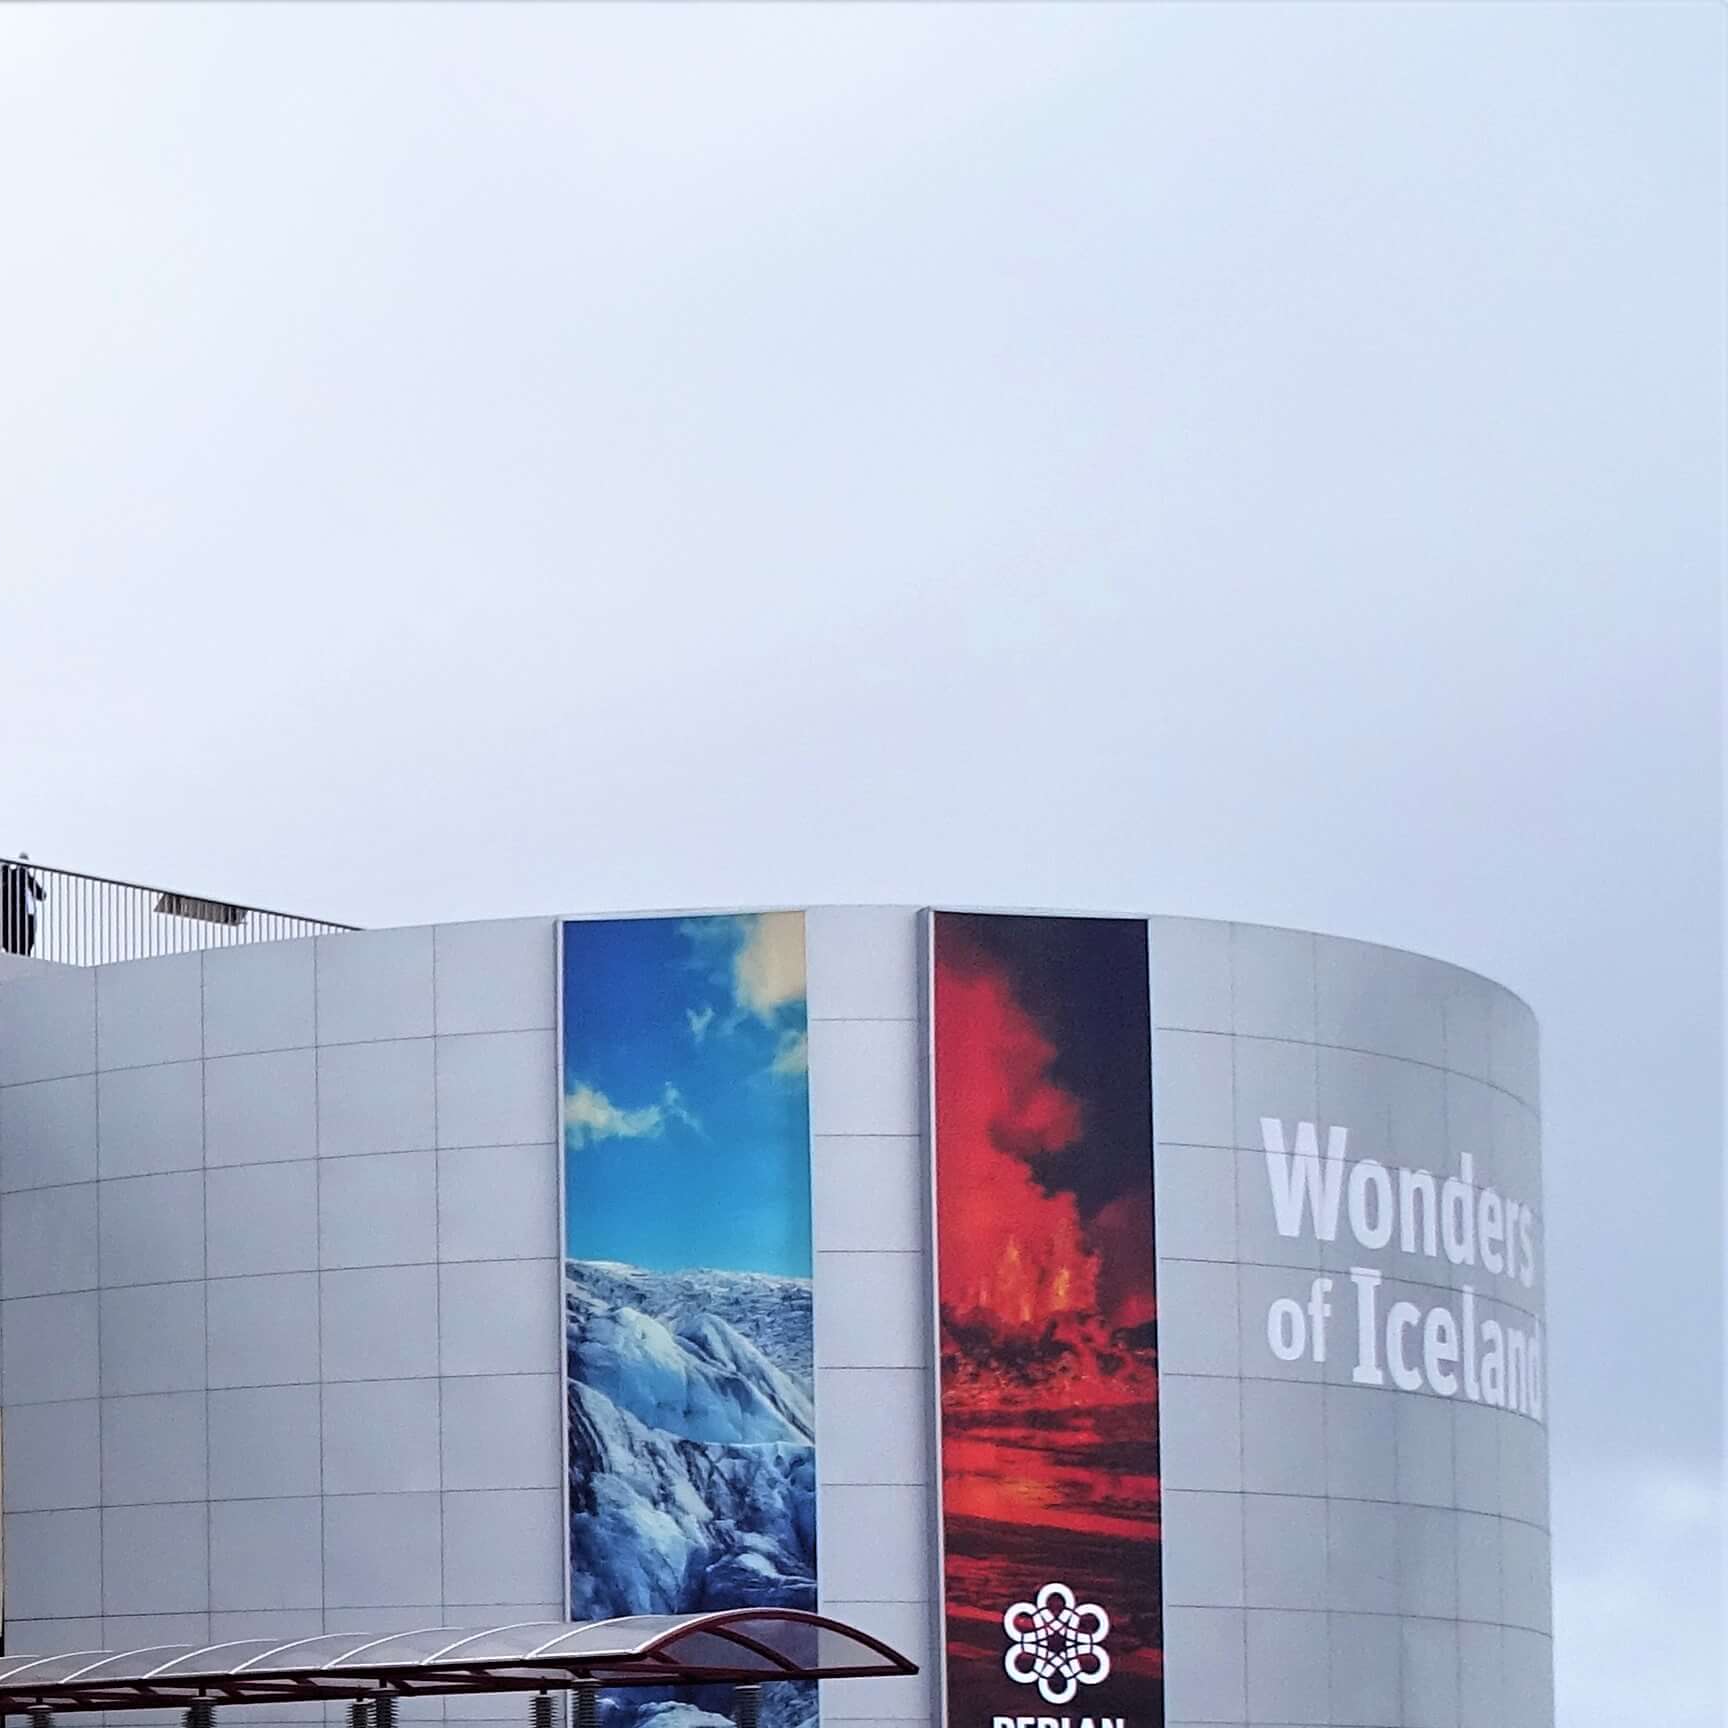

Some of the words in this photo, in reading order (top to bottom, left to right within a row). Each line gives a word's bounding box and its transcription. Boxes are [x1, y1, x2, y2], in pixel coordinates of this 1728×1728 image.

[1259, 1116, 1536, 1289] Wonders
[1267, 1277, 1333, 1363] of
[1349, 1266, 1543, 1424] Iceland
